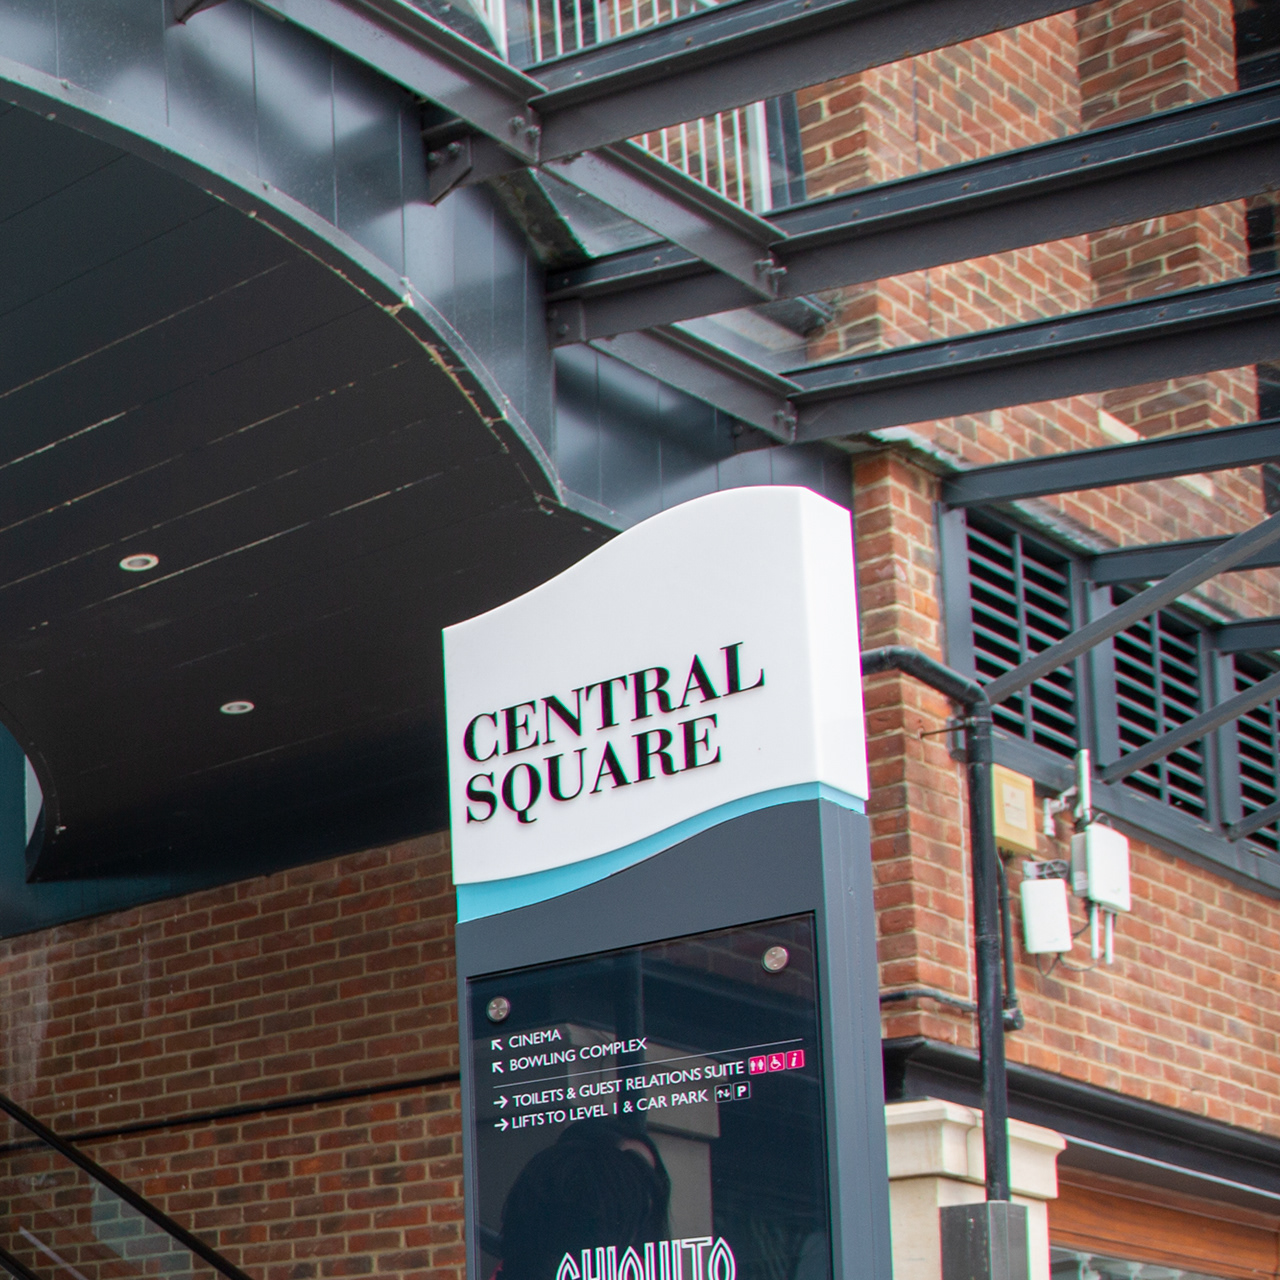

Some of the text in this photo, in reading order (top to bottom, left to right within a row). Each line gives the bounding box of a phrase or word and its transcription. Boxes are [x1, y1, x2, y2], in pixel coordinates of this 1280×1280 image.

[462, 641, 765, 764] CENTRAL
[464, 713, 722, 825] SQUARE
[508, 1028, 562, 1050] CINEMA
[509, 1037, 648, 1073] BOWLING COMPLEX
[512, 1087, 564, 1108] TOILETS
[566, 1086, 577, 1100] &
[579, 1079, 623, 1099] GUEST
[626, 1067, 702, 1092] RELATIONS
[704, 1060, 745, 1079] SUITE
[511, 1112, 544, 1130] LIFTS
[545, 1108, 566, 1125] TO
[569, 1103, 608, 1122] LEVEL
[623, 1098, 633, 1113] &
[636, 1094, 668, 1112] CAR
[671, 1088, 709, 1107] PARK
